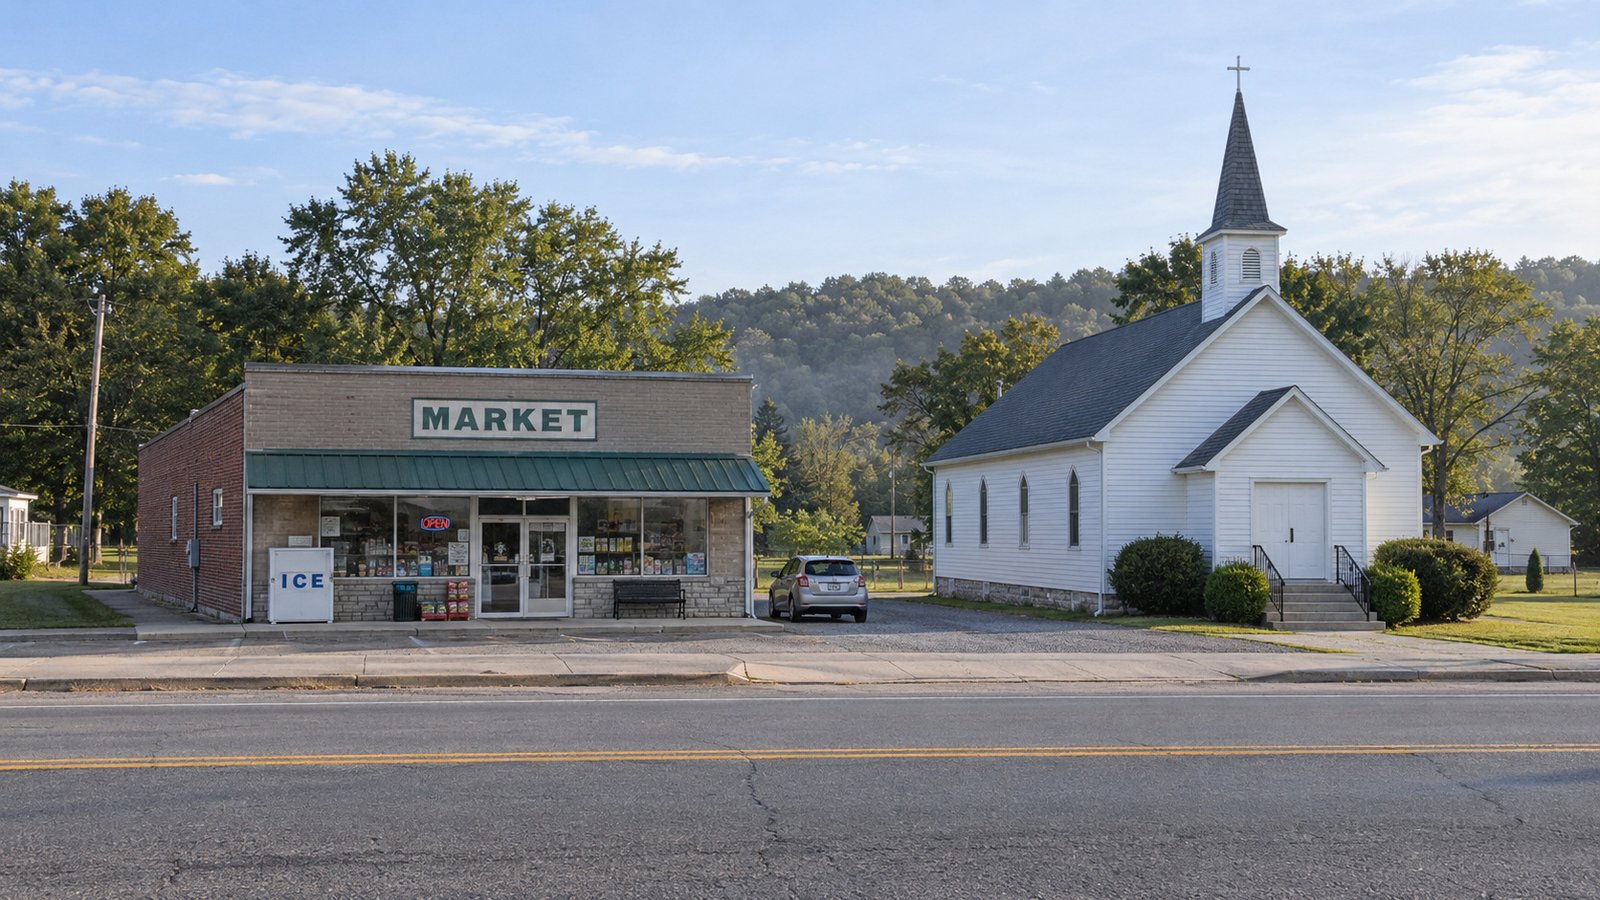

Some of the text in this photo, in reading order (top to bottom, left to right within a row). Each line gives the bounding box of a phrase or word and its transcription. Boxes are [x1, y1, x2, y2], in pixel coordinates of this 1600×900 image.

[422, 406, 588, 432] MARKET
[422, 517, 449, 528] OPEN
[282, 573, 324, 589] ICE
